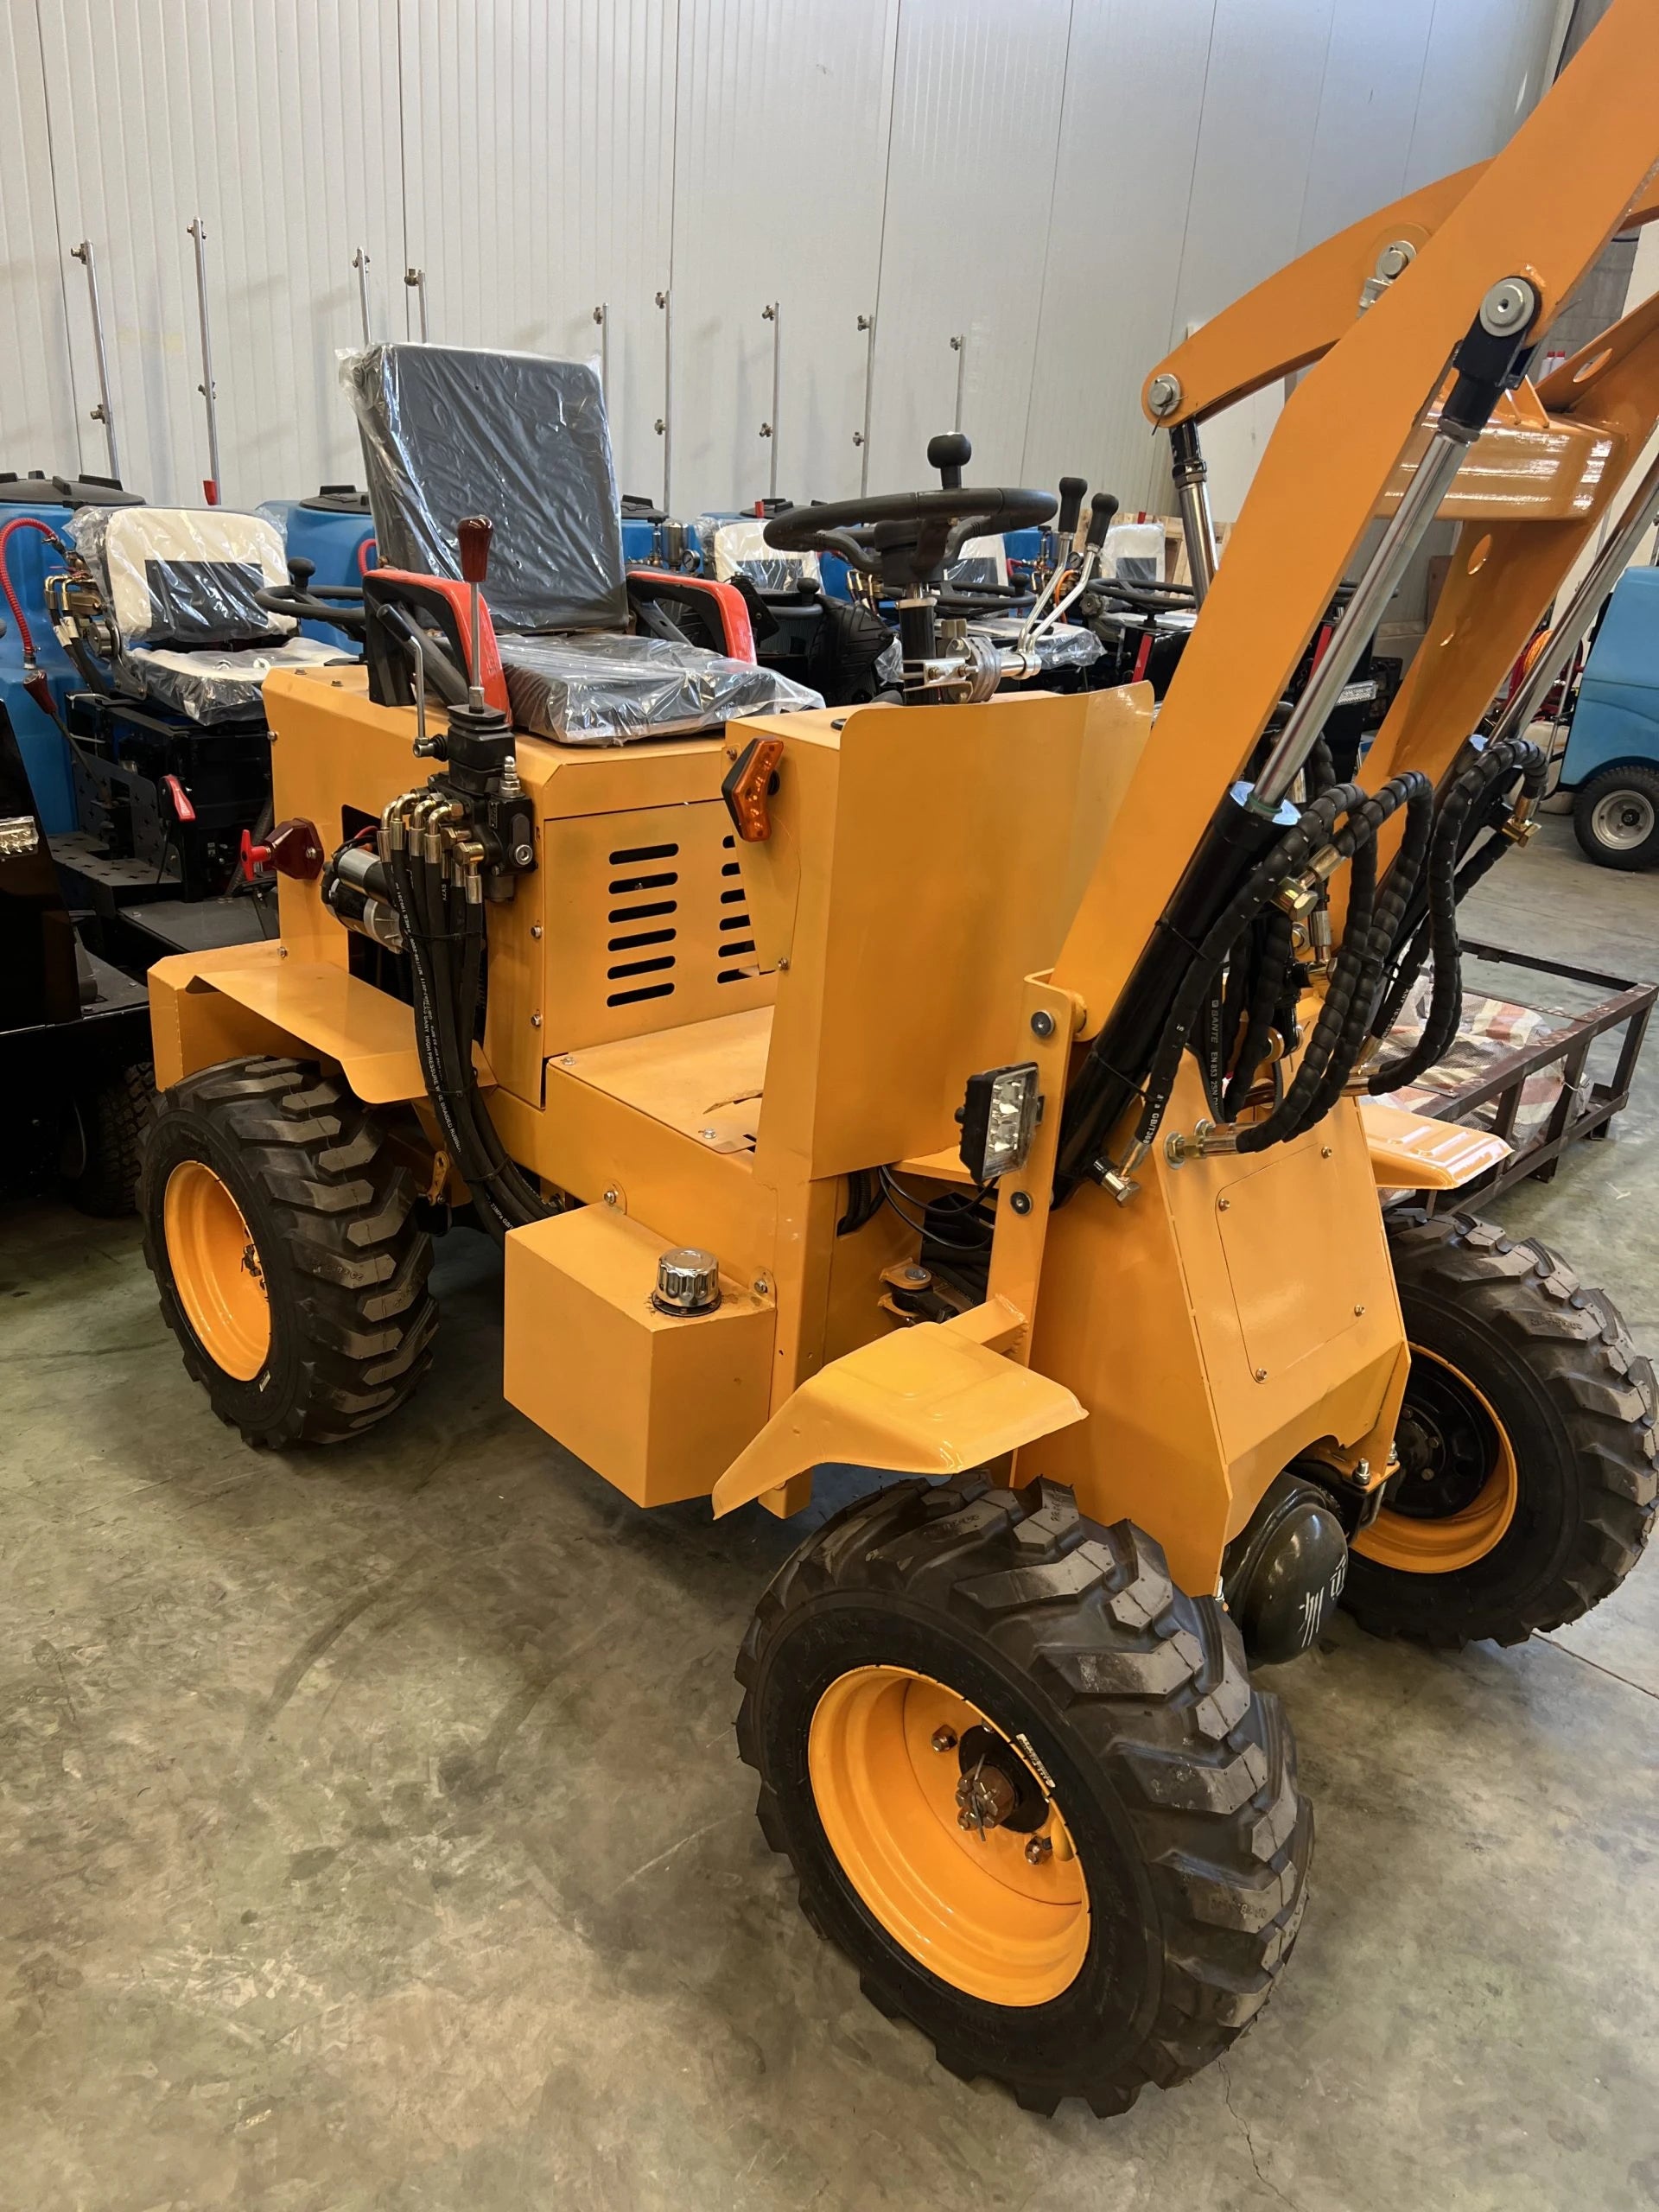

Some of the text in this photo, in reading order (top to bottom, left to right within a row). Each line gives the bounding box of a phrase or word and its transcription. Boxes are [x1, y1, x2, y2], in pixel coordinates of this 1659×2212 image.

[1211, 1009, 1219, 1045] SANTE
[1211, 1051, 1218, 1063] EN
[426, 1052, 440, 1086] PRESSURE
[440, 1102, 454, 1128] BRAIDED
